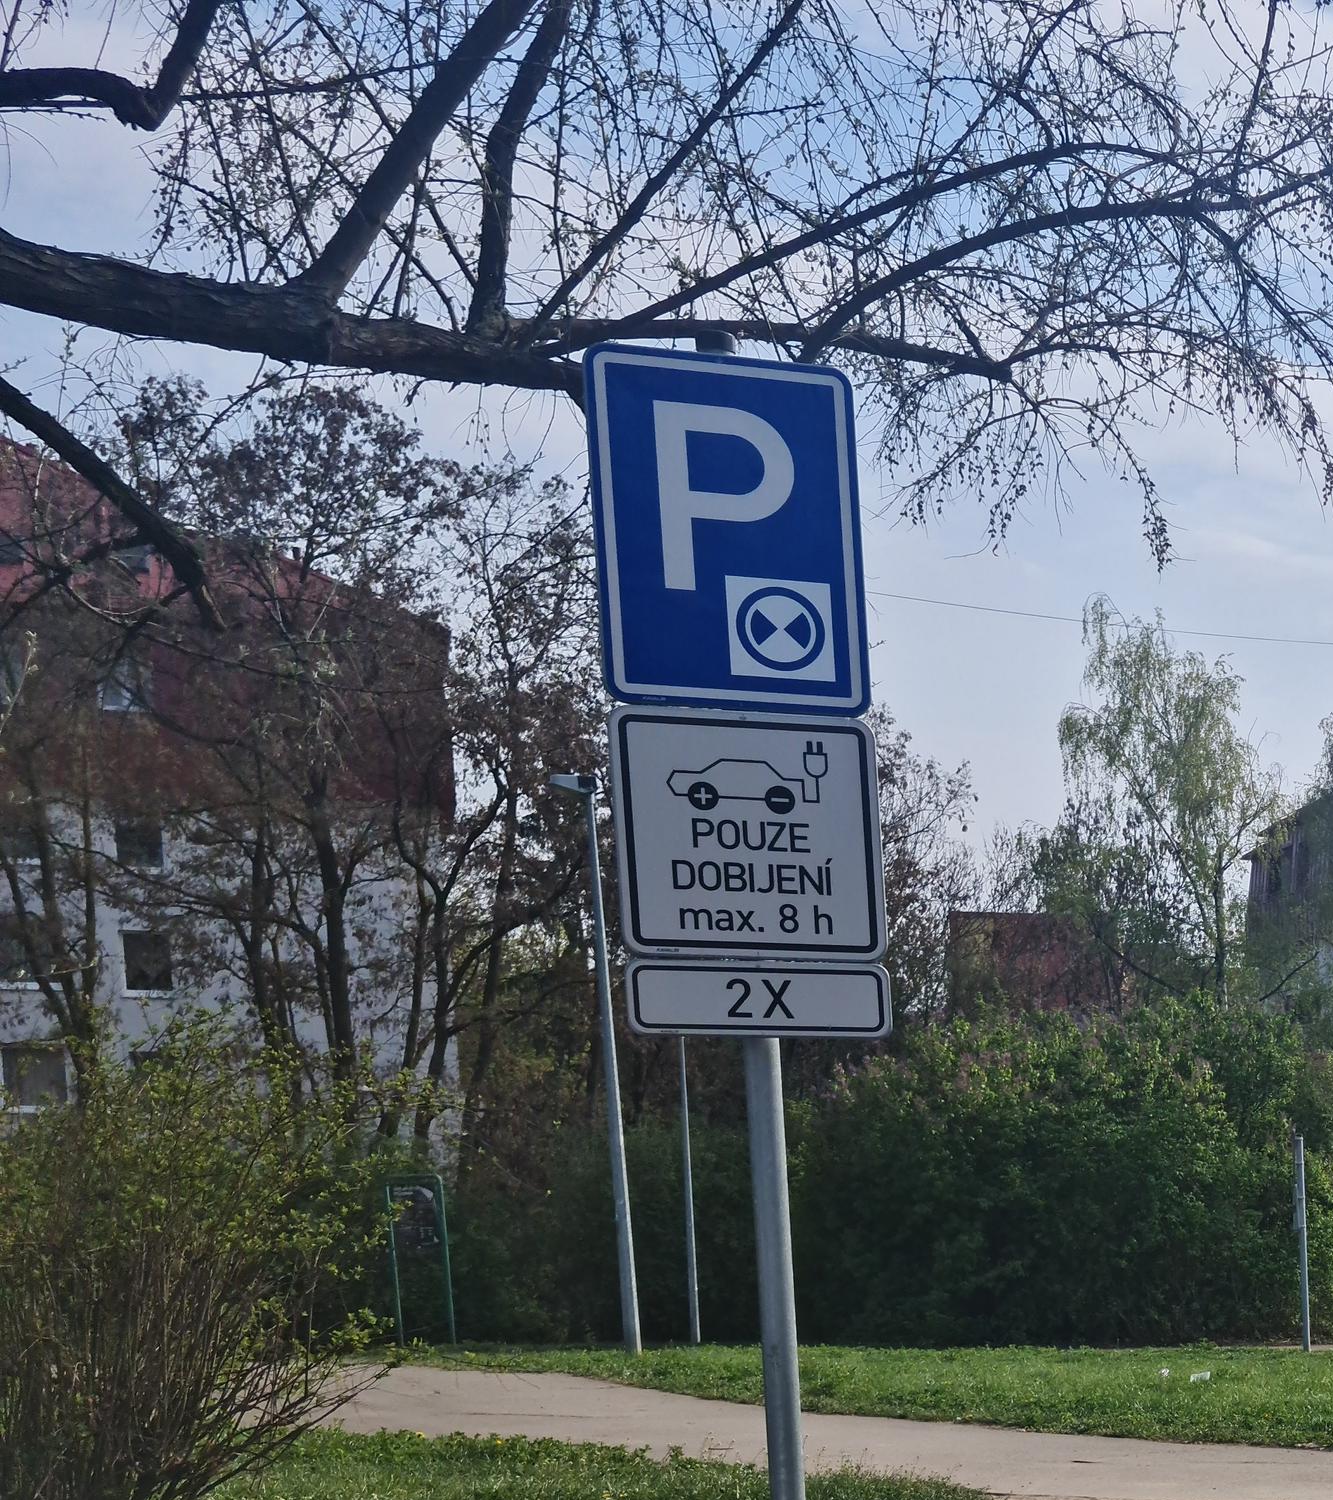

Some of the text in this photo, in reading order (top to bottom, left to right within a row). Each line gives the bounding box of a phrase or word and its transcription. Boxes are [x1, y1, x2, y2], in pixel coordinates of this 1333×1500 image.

[653, 399, 795, 591] P
[691, 817, 811, 853] POUZE
[671, 857, 833, 896] DOBIJENÍ
[678, 904, 834, 935] max. 8 h
[725, 978, 795, 1020] 2X
